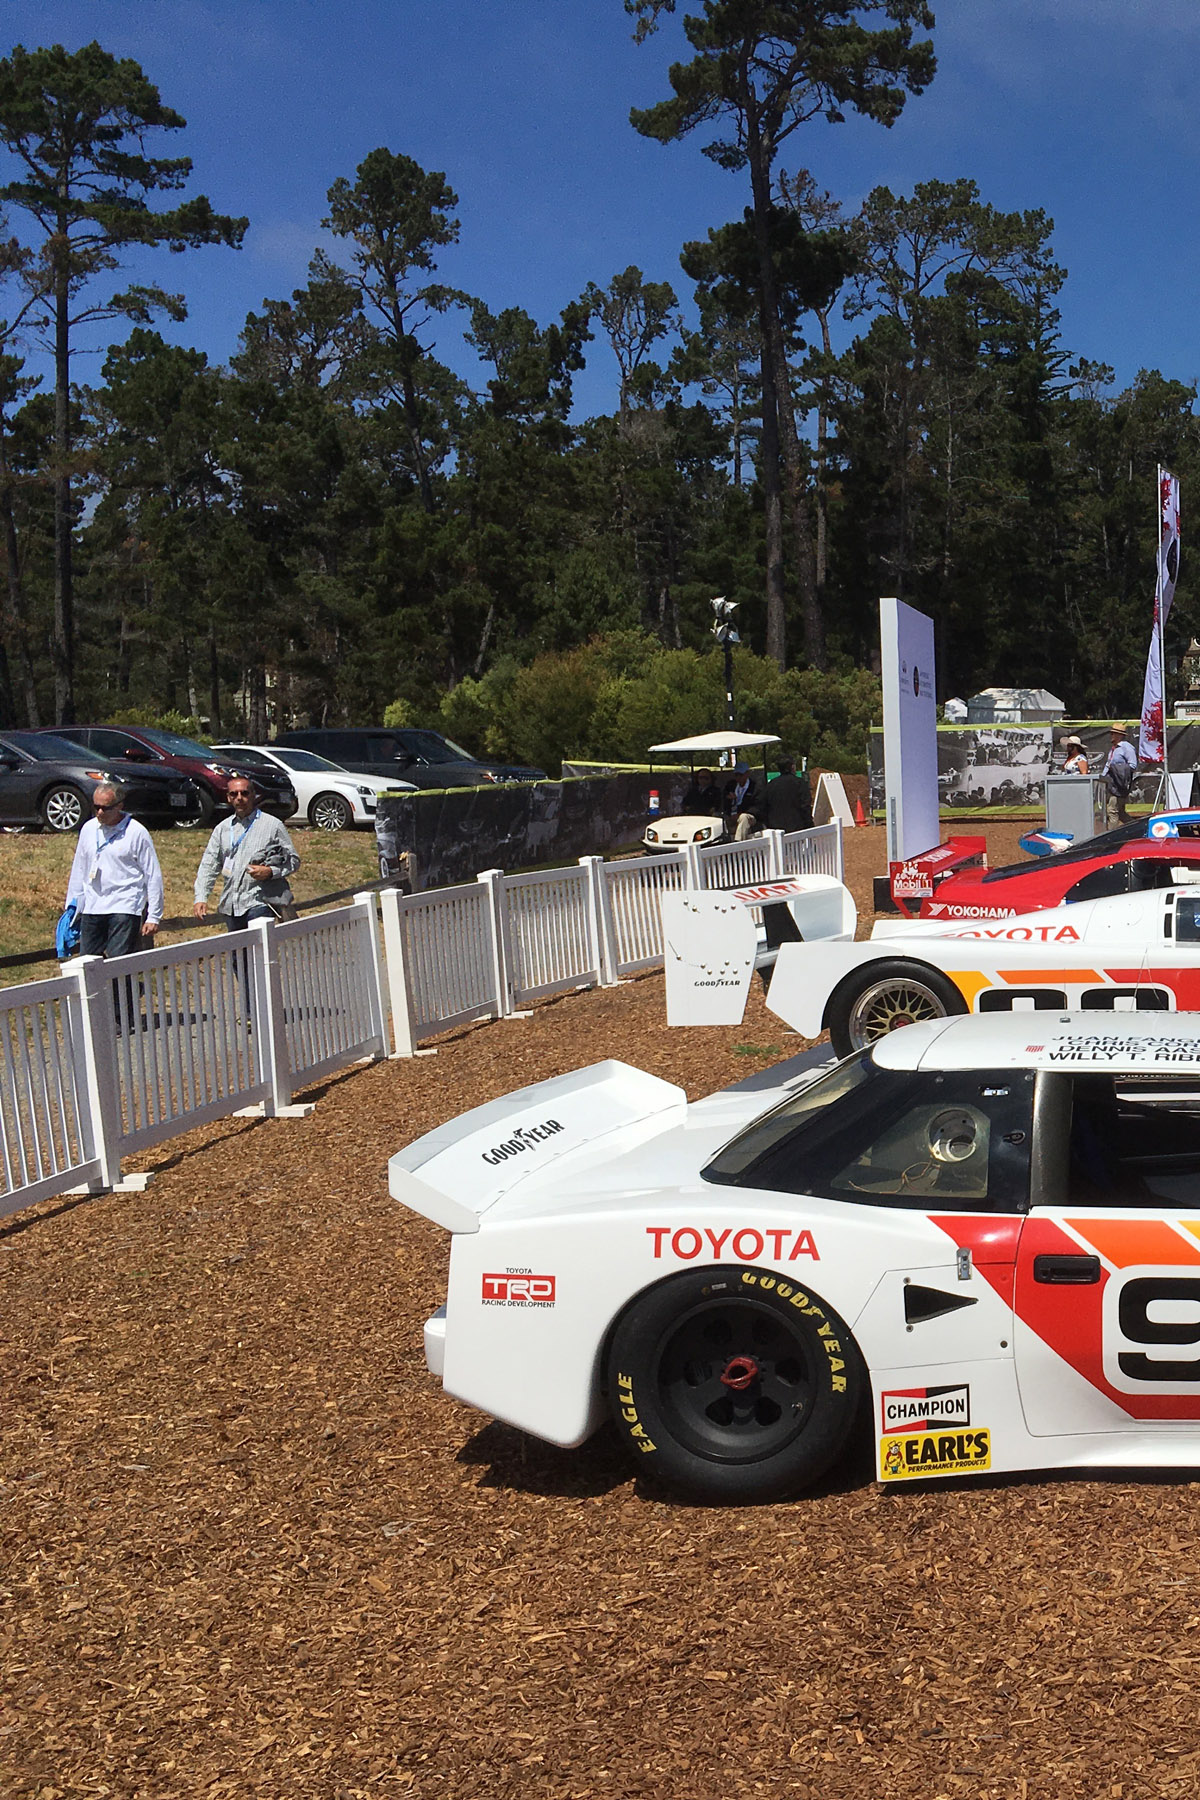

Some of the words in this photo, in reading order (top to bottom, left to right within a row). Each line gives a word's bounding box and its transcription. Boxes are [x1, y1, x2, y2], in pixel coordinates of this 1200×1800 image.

[893, 879, 921, 889] Mobil
[946, 904, 1017, 918] YOKOHAMA
[694, 978, 741, 988] GOODYEAR
[1049, 1052, 1120, 1061] WILLY
[1129, 1052, 1146, 1061] T.
[481, 1119, 566, 1166] GOODYEAR
[646, 1226, 822, 1262] TOYOTA
[505, 1267, 533, 1275] TOYOTA
[484, 1278, 553, 1301] TRD
[481, 1299, 507, 1307] RACING
[507, 1300, 556, 1308] DEVELOPMENT
[741, 1271, 848, 1393] GOODYEAR
[618, 1372, 658, 1453] EAGLE
[887, 1398, 966, 1419] CHAMPION
[905, 1432, 989, 1466] EARL'S
[907, 1463, 954, 1473] PERFORMANCE
[955, 1458, 987, 1468] PRODUCTS
